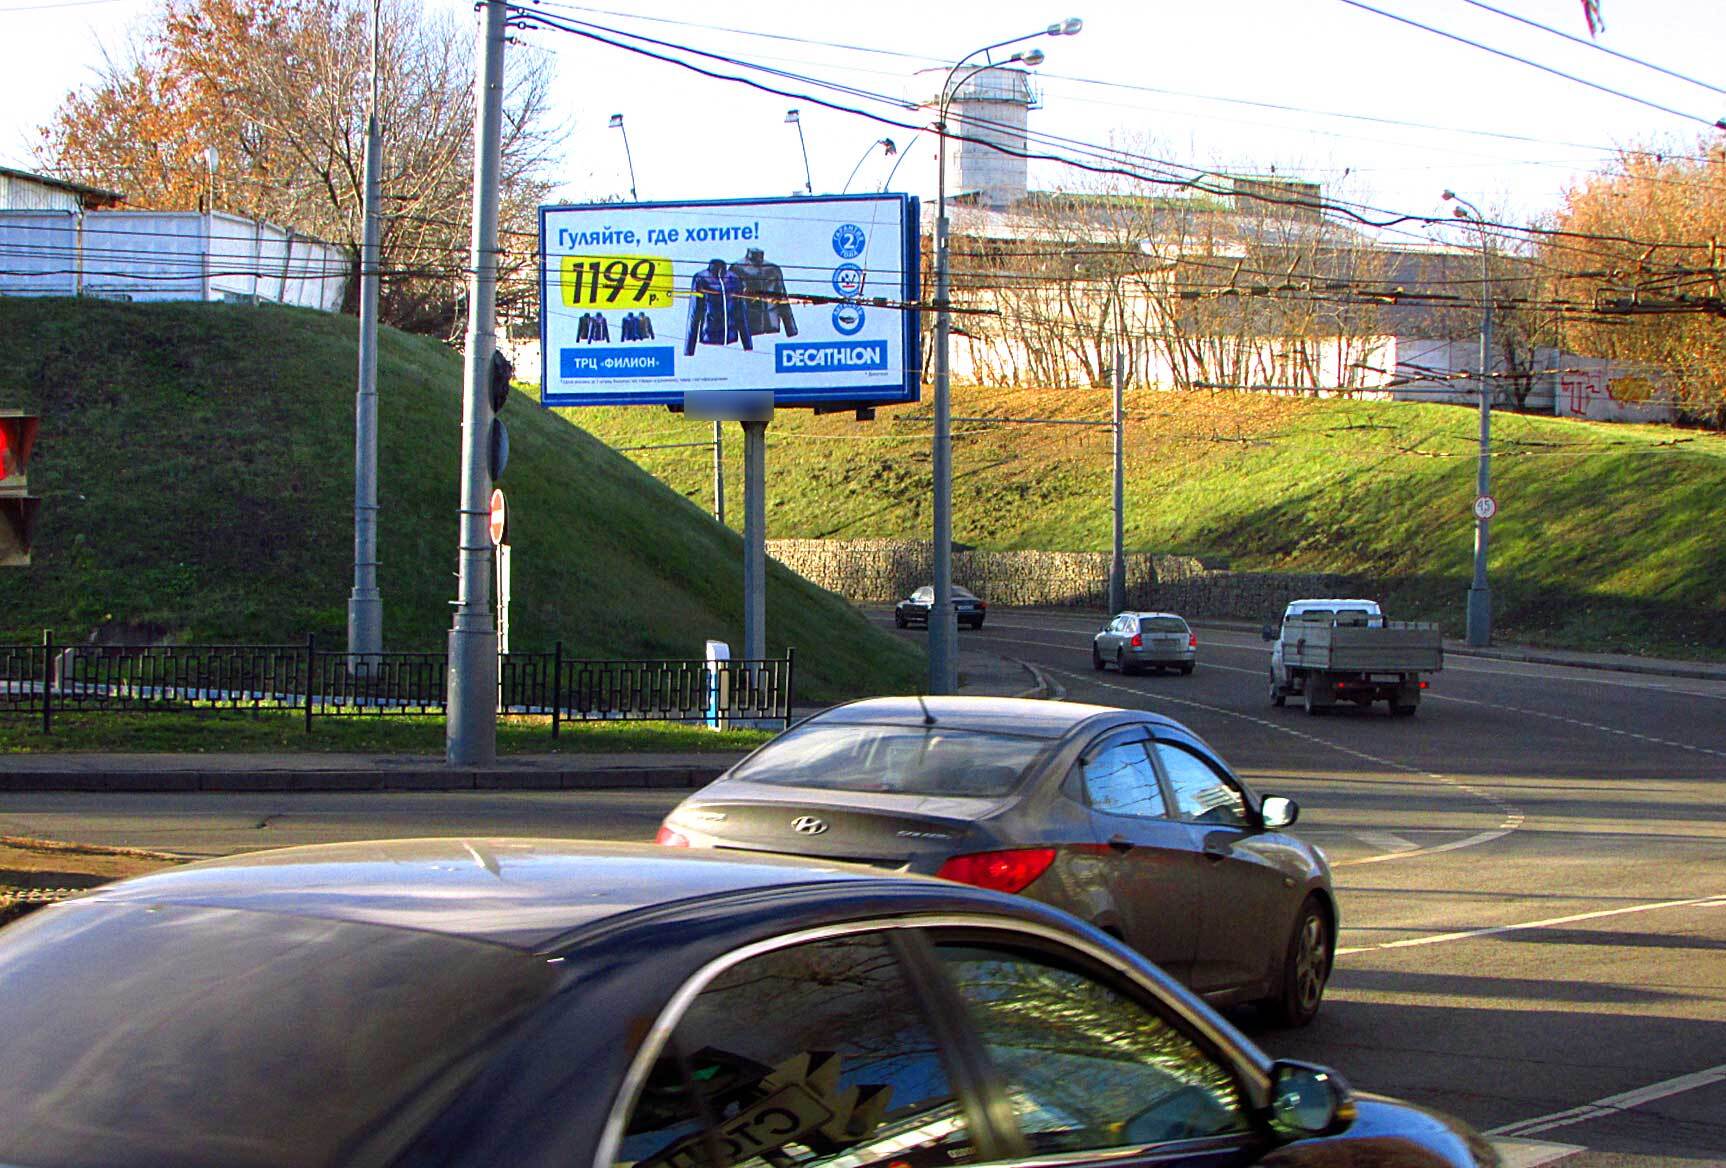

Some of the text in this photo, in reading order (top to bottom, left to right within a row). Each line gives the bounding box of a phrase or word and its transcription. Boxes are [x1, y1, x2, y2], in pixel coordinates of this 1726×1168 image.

[559, 222, 760, 250] Гуляйте, где хотите!
[843, 233, 855, 250] 2
[574, 357, 598, 370] ТРЦ
[782, 346, 880, 367] DECATHLON
